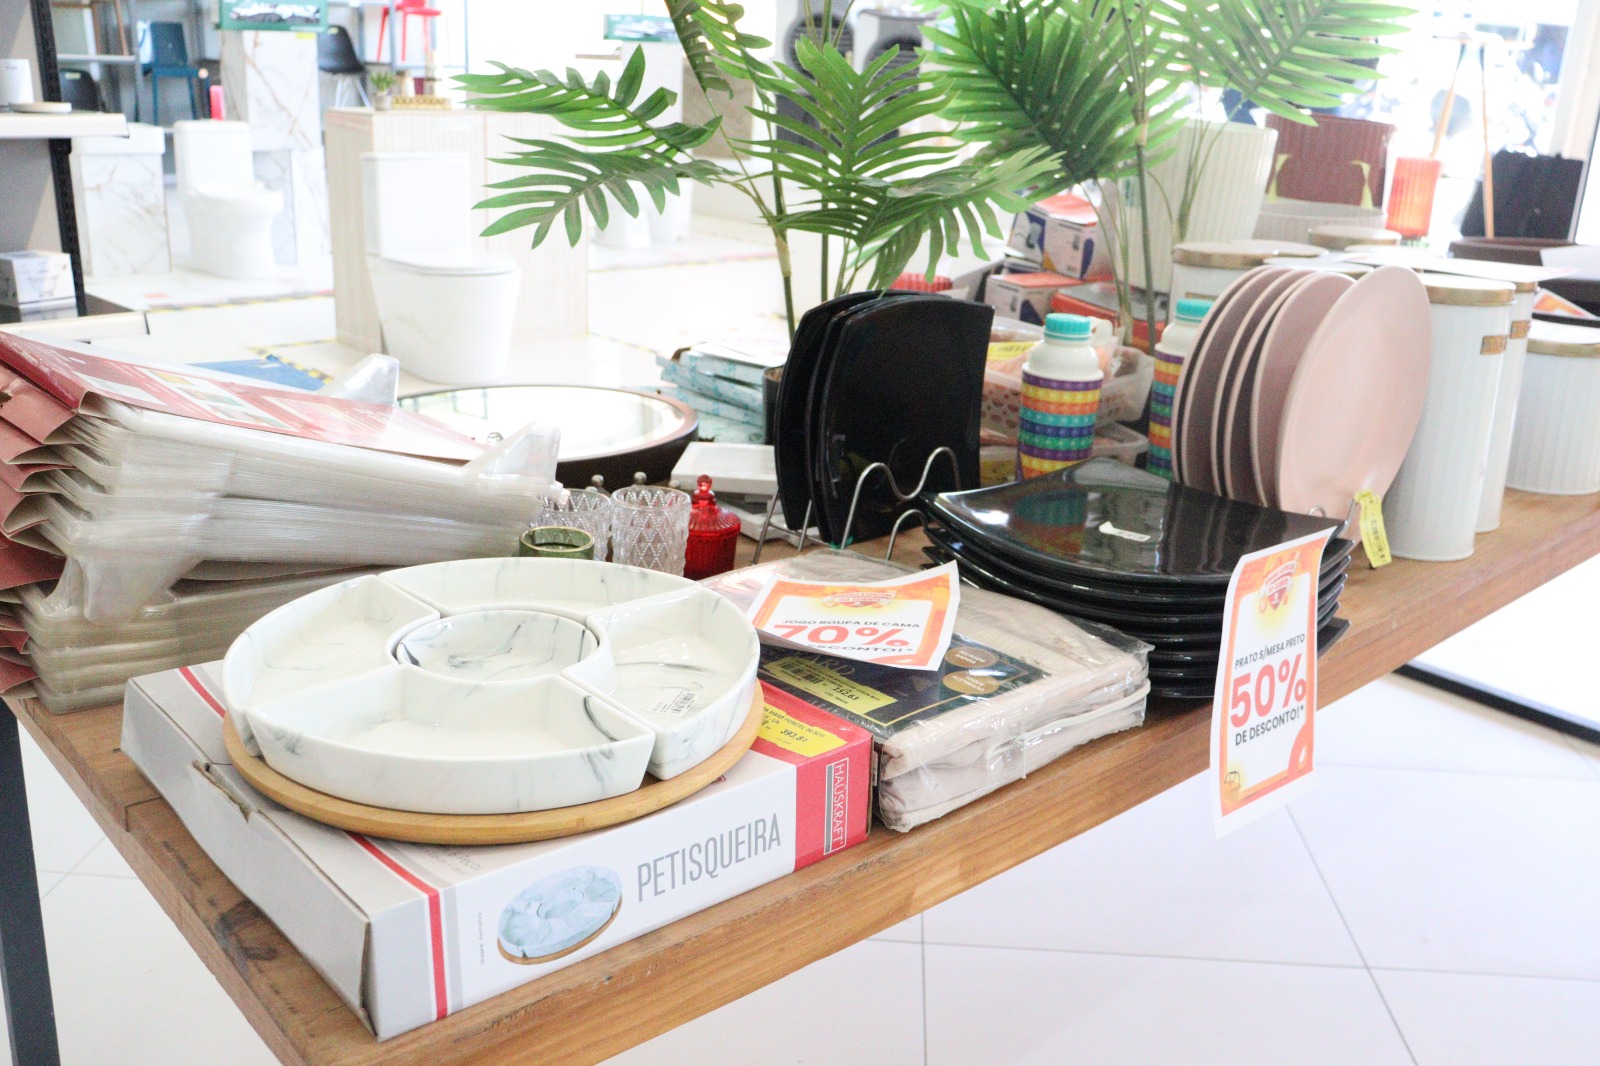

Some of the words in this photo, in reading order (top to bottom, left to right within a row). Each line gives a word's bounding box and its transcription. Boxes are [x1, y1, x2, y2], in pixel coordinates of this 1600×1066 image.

[773, 624, 910, 647] 70%
[807, 644, 914, 653] ESCONTO!
[1235, 652, 1259, 670] PRATO
[1259, 642, 1285, 661] S/MESA
[1285, 633, 1306, 650] PRETO
[1230, 653, 1307, 729] 50%
[1235, 727, 1248, 746] DE
[637, 812, 782, 903] PETISQUEIRA
